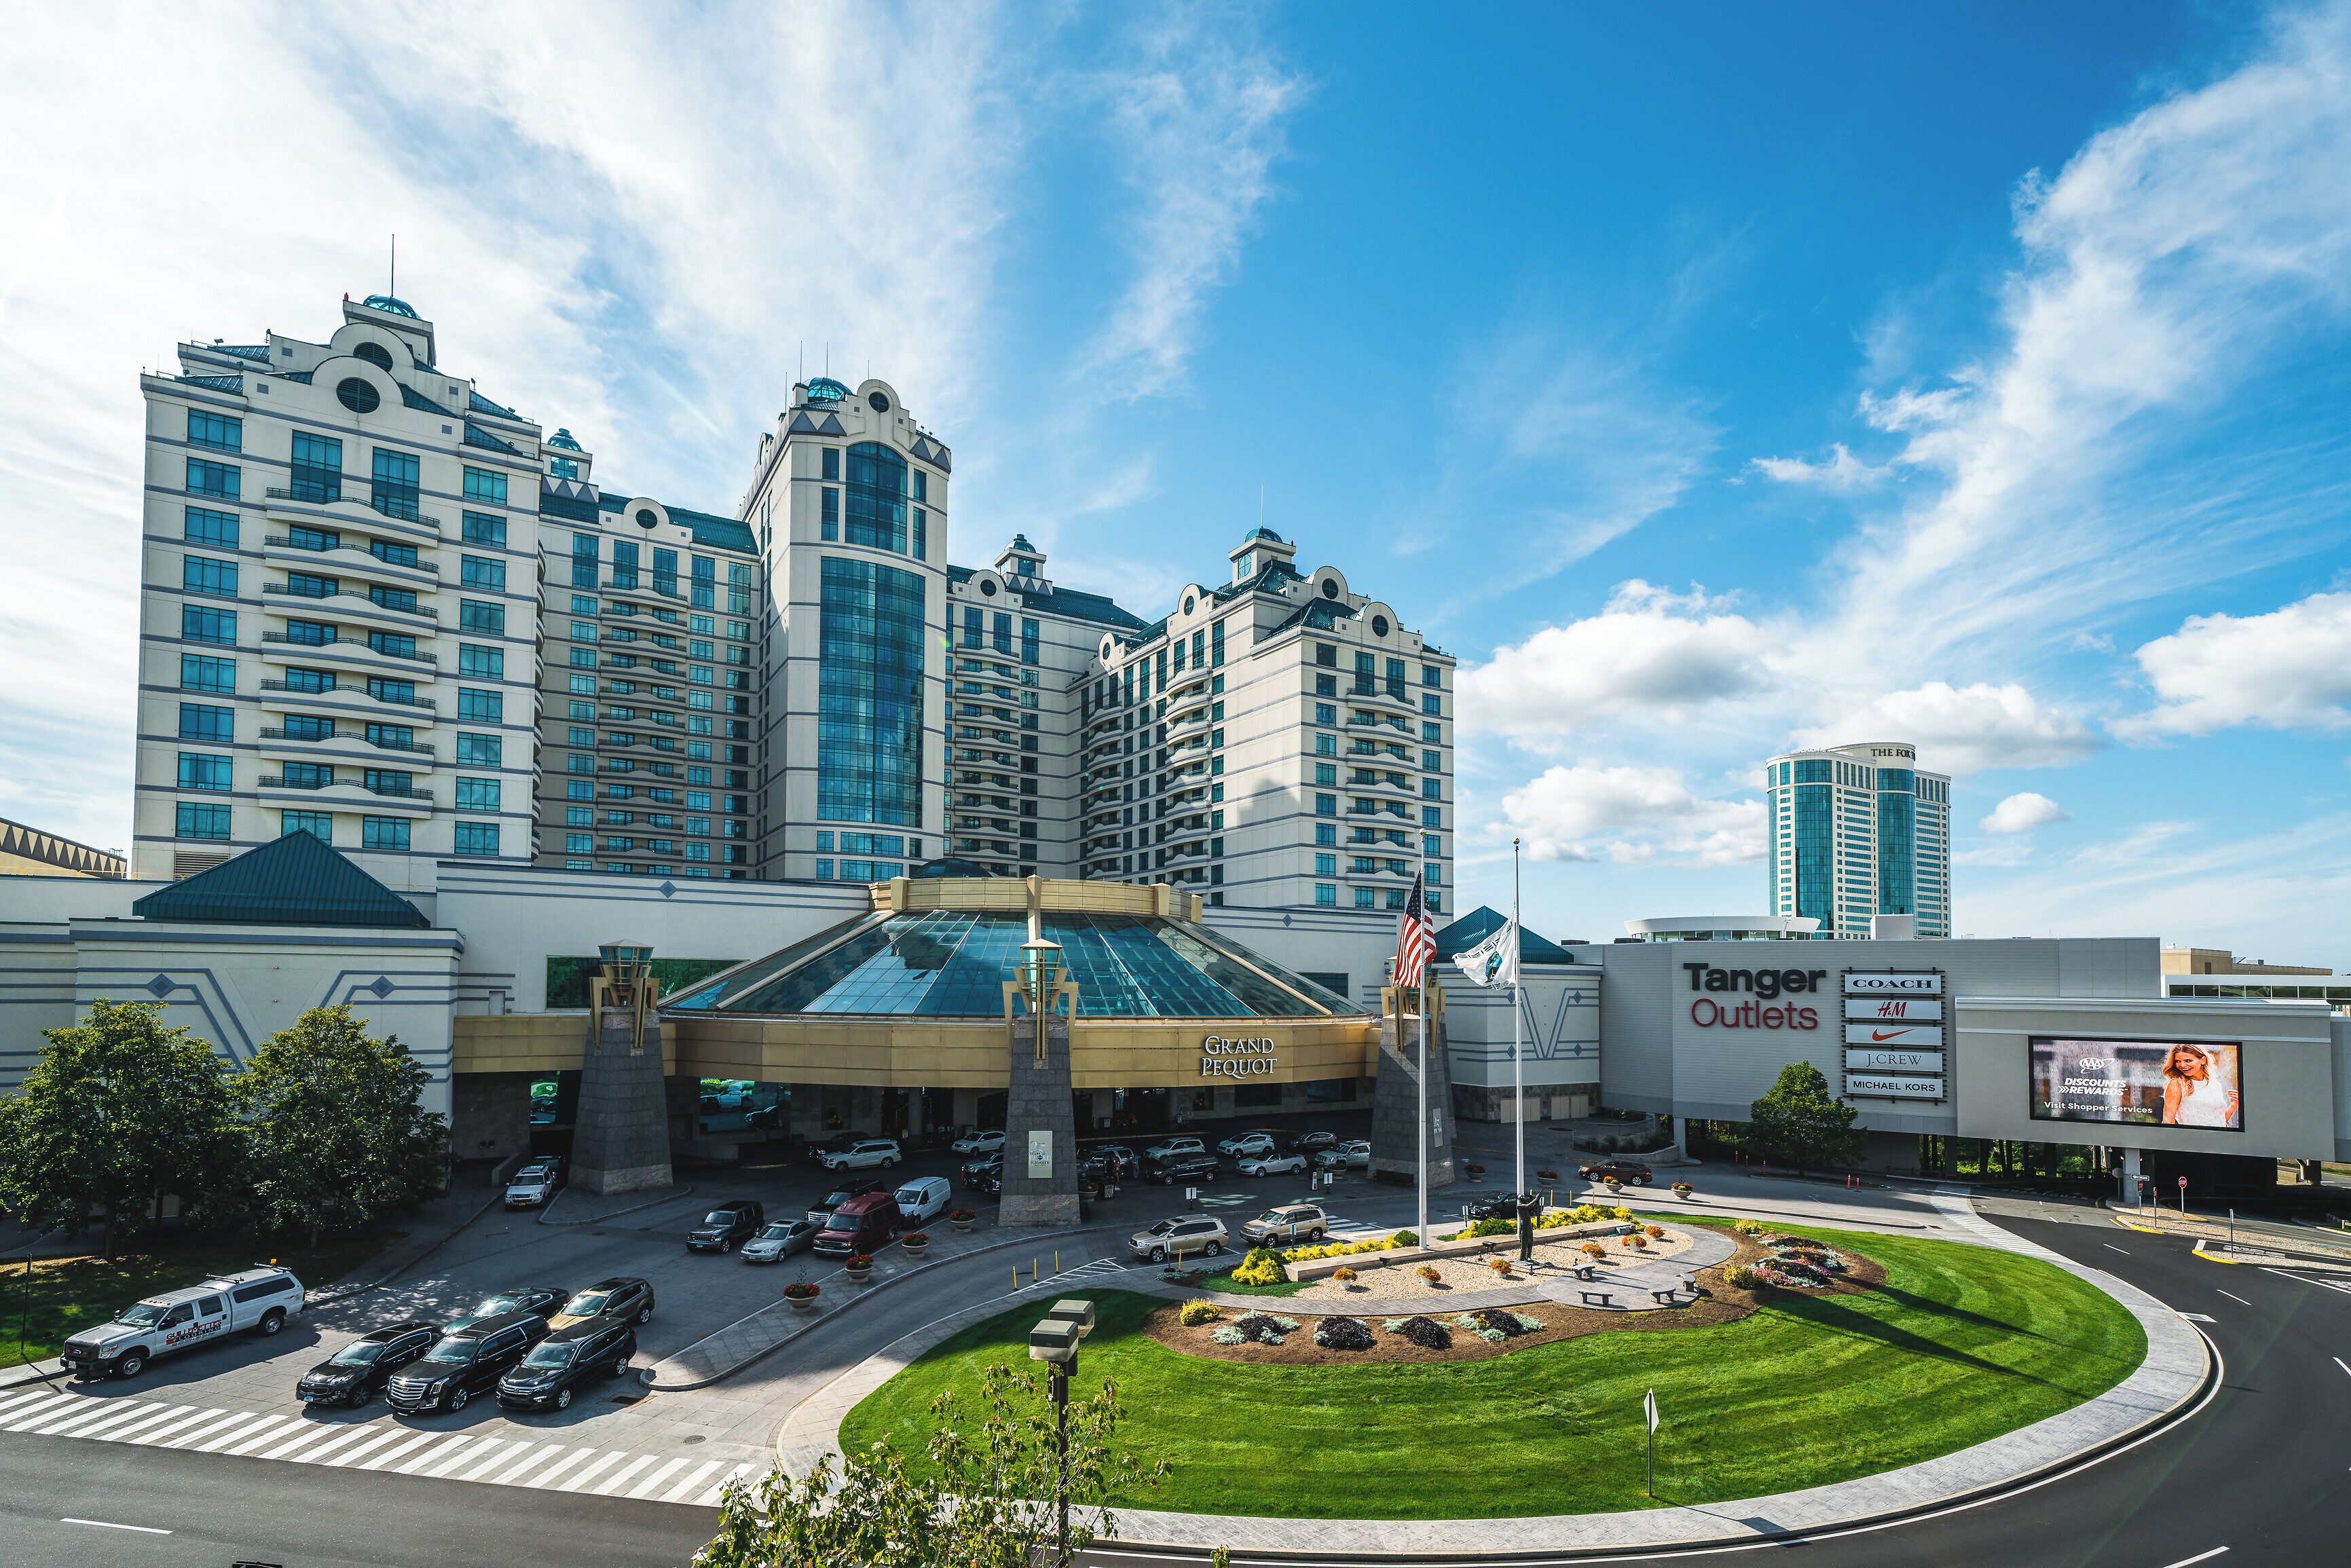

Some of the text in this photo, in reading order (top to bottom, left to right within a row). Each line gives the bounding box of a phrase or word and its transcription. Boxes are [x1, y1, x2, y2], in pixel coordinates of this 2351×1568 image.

[1896, 749, 1910, 758] FOX
[1683, 963, 1826, 999] Tanger
[1852, 979, 1933, 988] COACH
[1691, 998, 1818, 1030] Outlets
[1877, 1001, 1907, 1018] H&M
[1204, 1035, 1274, 1055] GRAND
[1866, 1054, 1922, 1067] J.CREW
[1201, 1058, 1278, 1079] PEQUOT
[1853, 1081, 1936, 1092] MICHAEL KORS
[2065, 1077, 2126, 1087] DISCOUNTS
[2069, 1086, 2124, 1096] REWARDS
[2068, 1102, 2109, 1112] Shopper
[2111, 1106, 2153, 1114] Services
[1030, 1140, 1045, 1155] 25
[173, 1326, 220, 1343] FLOORING
